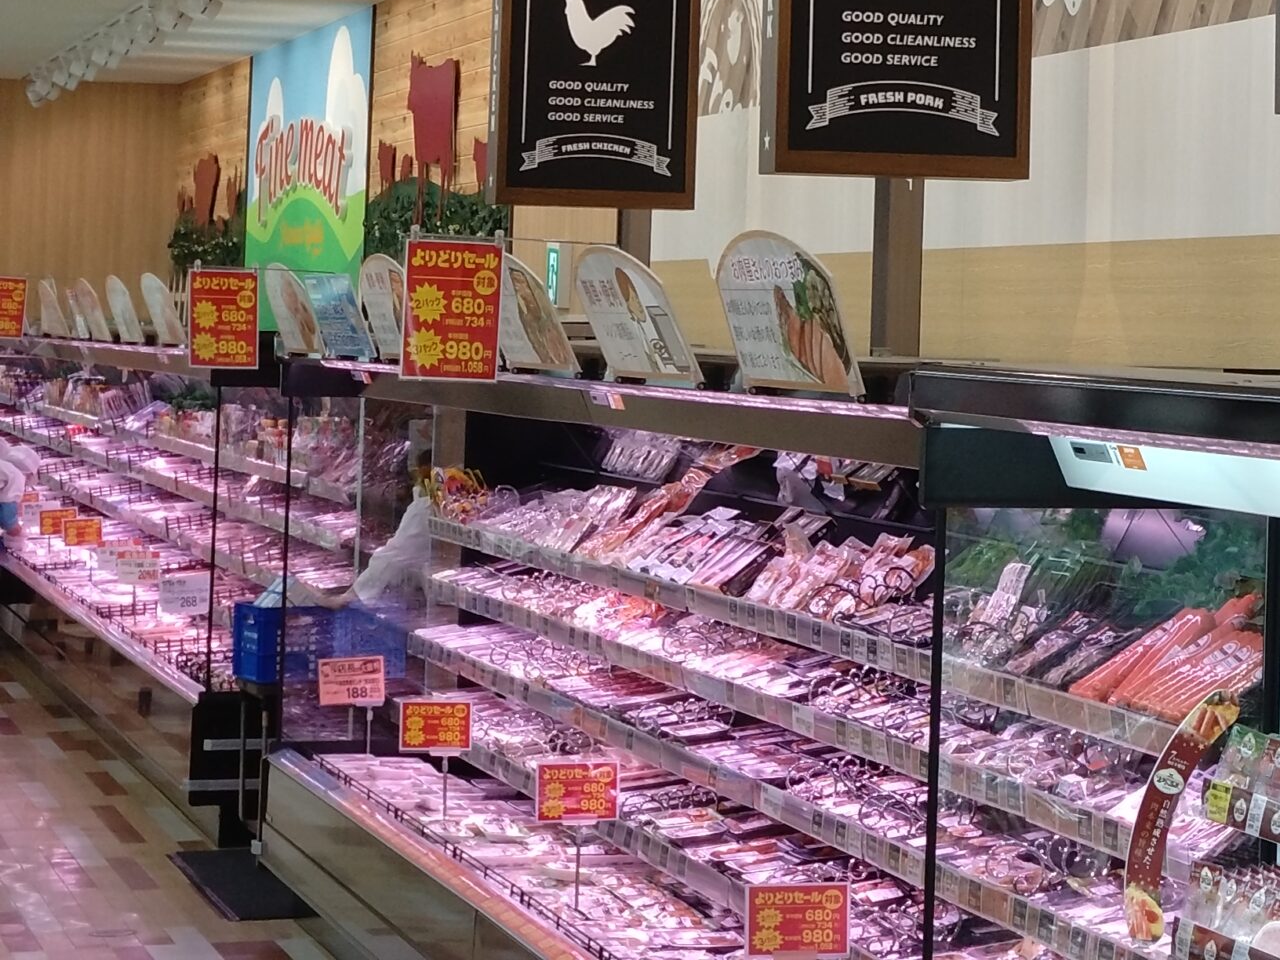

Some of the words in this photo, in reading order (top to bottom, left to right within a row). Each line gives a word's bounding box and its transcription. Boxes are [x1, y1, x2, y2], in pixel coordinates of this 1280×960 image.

[841, 10, 884, 24] GOOD
[887, 12, 944, 27] QUALITY
[841, 32, 884, 46] GOOD
[840, 52, 883, 65] GOOD
[886, 54, 939, 67] SERVICE
[548, 80, 582, 91] GOOD
[584, 81, 630, 93] QUALITY
[548, 96, 581, 107] GOOD
[859, 92, 904, 106] FRESH
[907, 92, 945, 110] PORK
[547, 111, 581, 122] GOOD
[583, 113, 625, 124] SERVICE
[561, 142, 591, 153] FRESH
[591, 142, 631, 155] CHICKEN
[255, 119, 294, 227] Fine
[296, 117, 346, 216] meat
[411, 248, 499, 270] よりどりセール
[192, 276, 256, 291] よりどりセール
[414, 296, 442, 310] 2パック
[180, 595, 198, 608] 268
[346, 686, 368, 699] 188
[754, 891, 823, 905] よりどりセール
